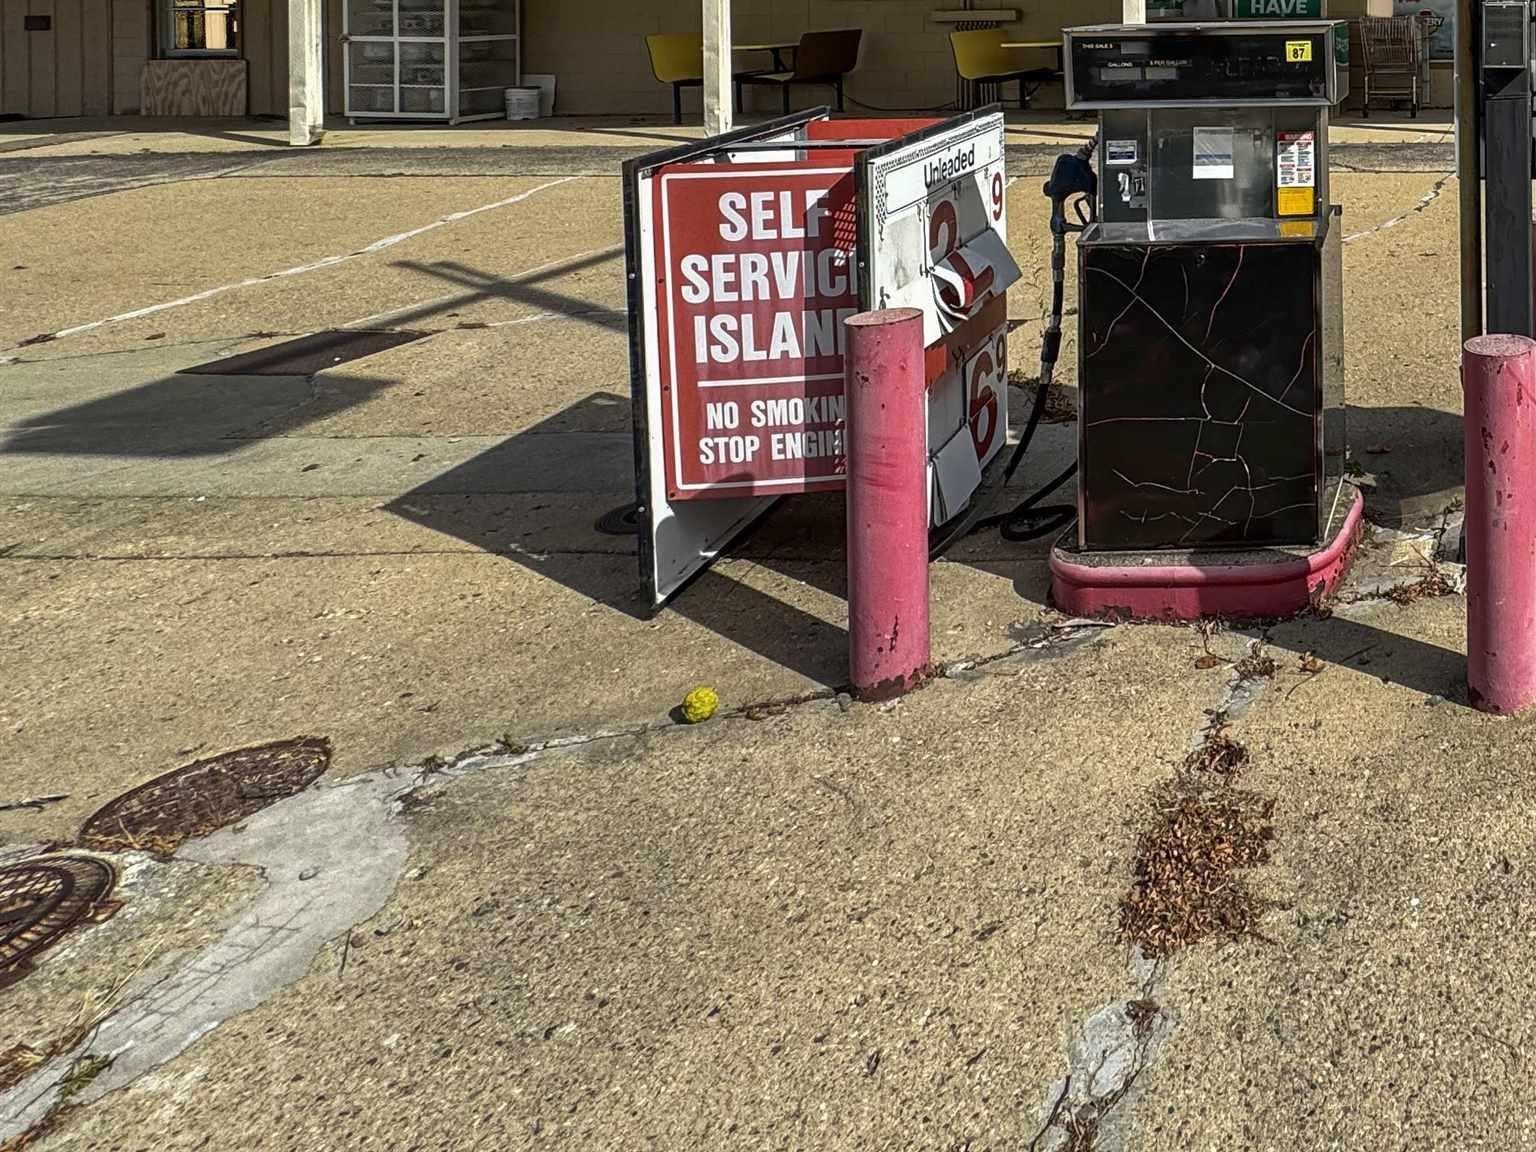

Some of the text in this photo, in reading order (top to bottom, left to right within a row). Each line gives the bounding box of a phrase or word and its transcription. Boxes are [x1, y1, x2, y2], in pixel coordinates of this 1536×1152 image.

[1250, 0, 1308, 15] HAVE
[1292, 47, 1305, 60] 87
[923, 143, 975, 189] Unleaded
[718, 189, 830, 242] SELF
[991, 171, 1003, 222] 9
[706, 395, 846, 430] NO SMOKIN
[969, 350, 998, 460] 6
[698, 435, 760, 464] STOP
